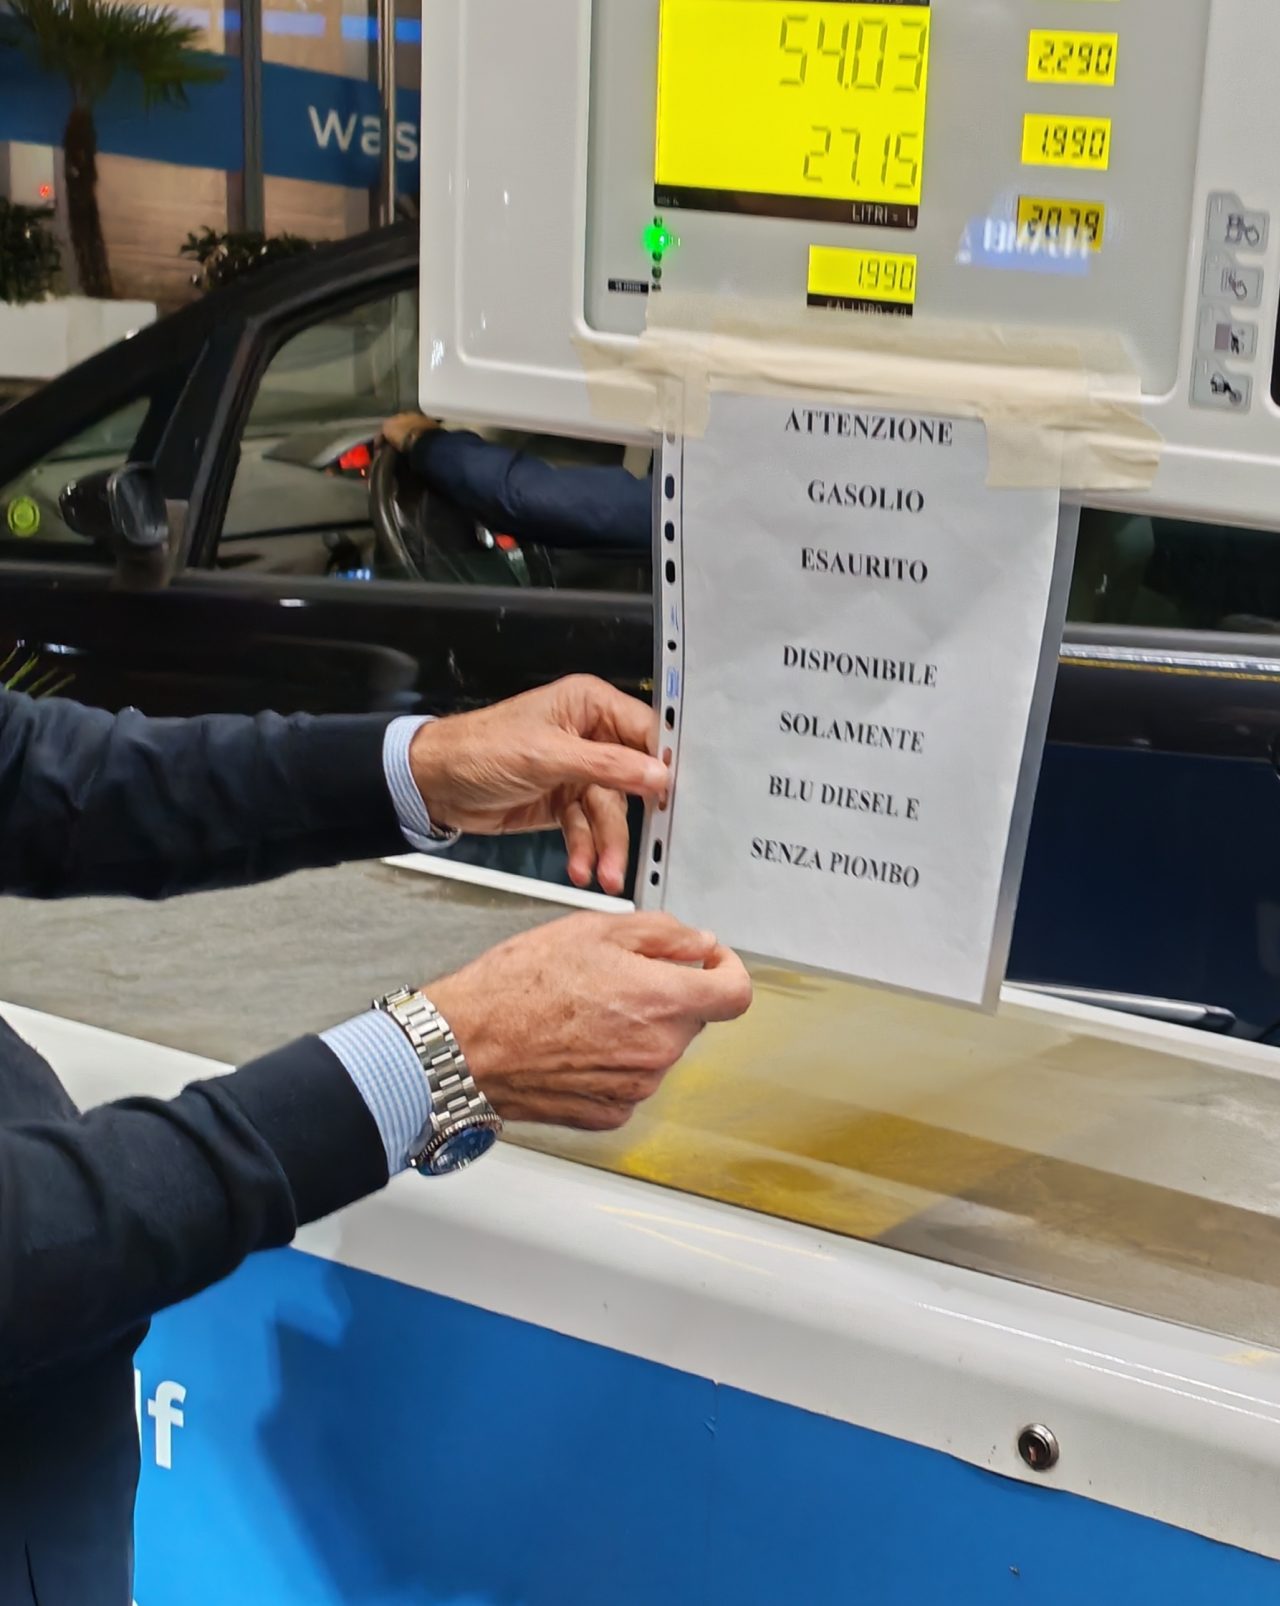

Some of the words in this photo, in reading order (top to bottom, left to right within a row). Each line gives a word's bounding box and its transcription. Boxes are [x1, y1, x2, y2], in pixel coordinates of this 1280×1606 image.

[1037, 40, 1113, 75] 2.290
[1041, 125, 1106, 159] 1.990
[852, 203, 888, 225] LITRI
[785, 409, 954, 446] ATTENZIONE
[807, 479, 925, 514] GASOLIO
[801, 547, 928, 583] ESAURITO
[783, 645, 938, 687] DISPONIBILE
[779, 711, 925, 753] SOLAMENTE
[769, 774, 814, 803] BLU
[820, 783, 898, 818] DIESEL
[906, 797, 920, 821] E
[750, 838, 822, 871] SENZA
[829, 851, 920, 889] PIOMBO
